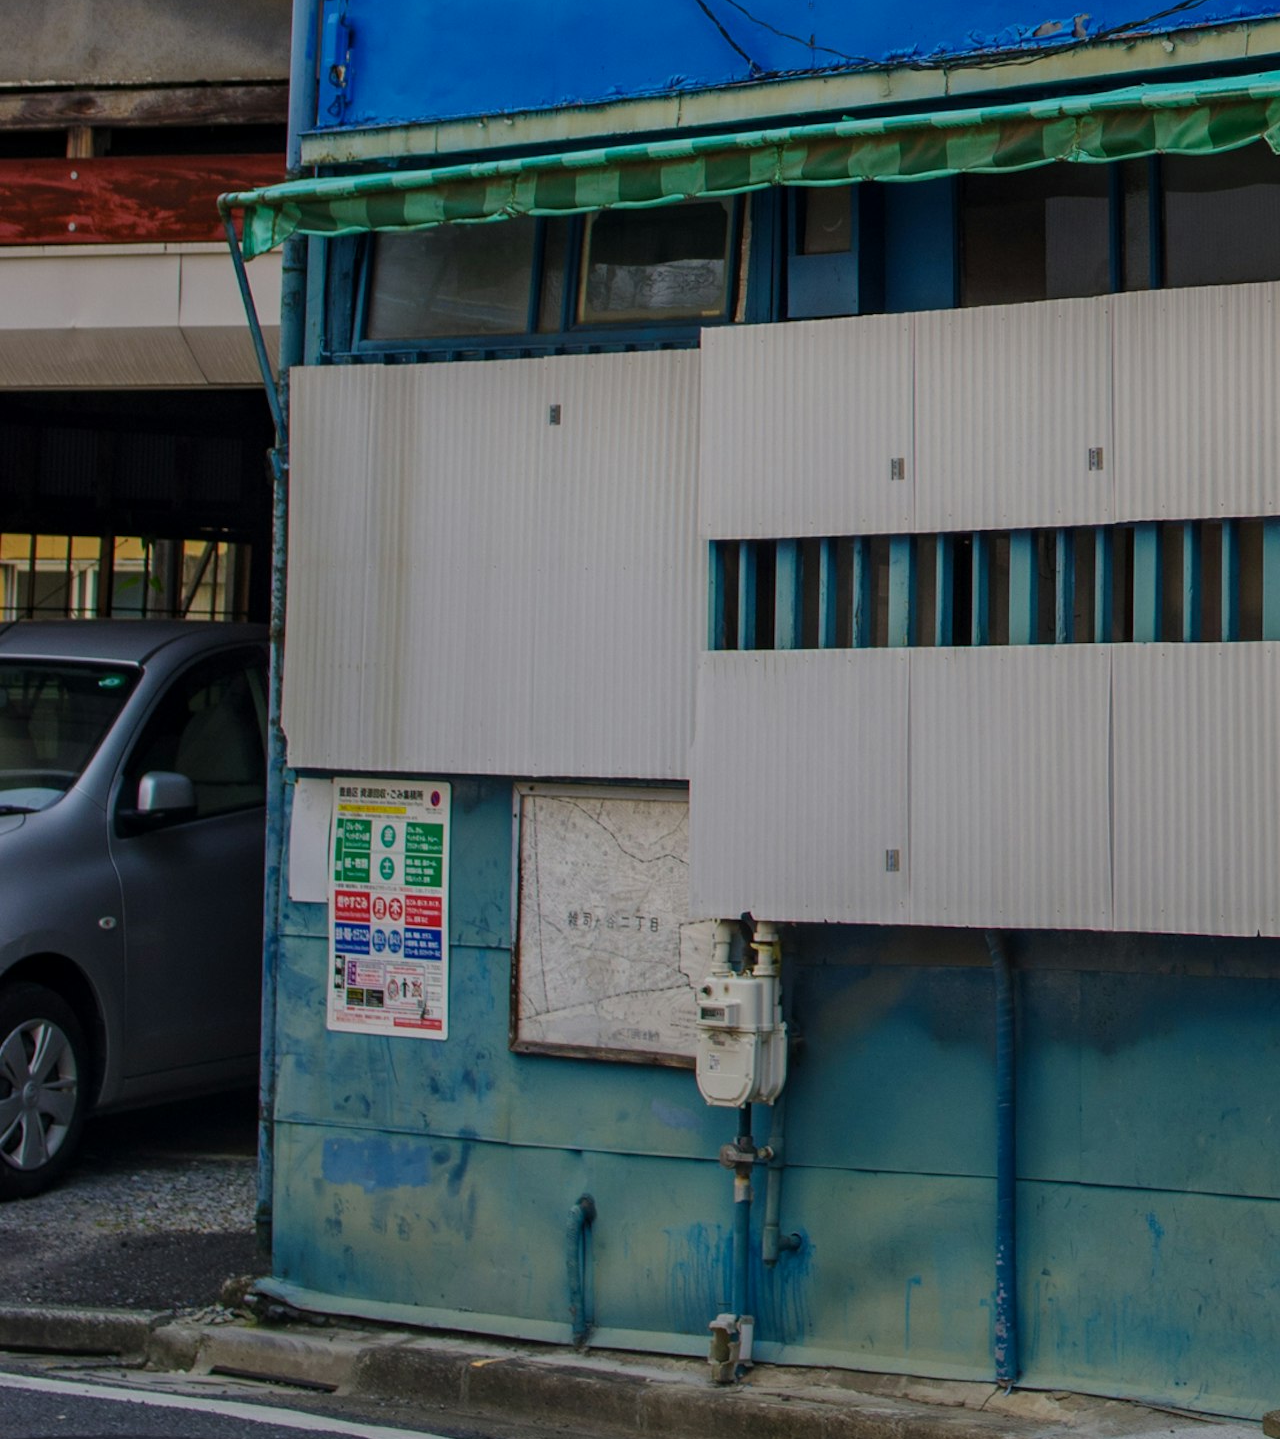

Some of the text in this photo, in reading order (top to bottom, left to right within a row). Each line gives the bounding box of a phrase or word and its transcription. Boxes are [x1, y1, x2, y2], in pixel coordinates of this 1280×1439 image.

[383, 828, 393, 841] 金
[382, 859, 392, 873] 土
[375, 898, 384, 913] 月
[390, 900, 402, 914] 木
